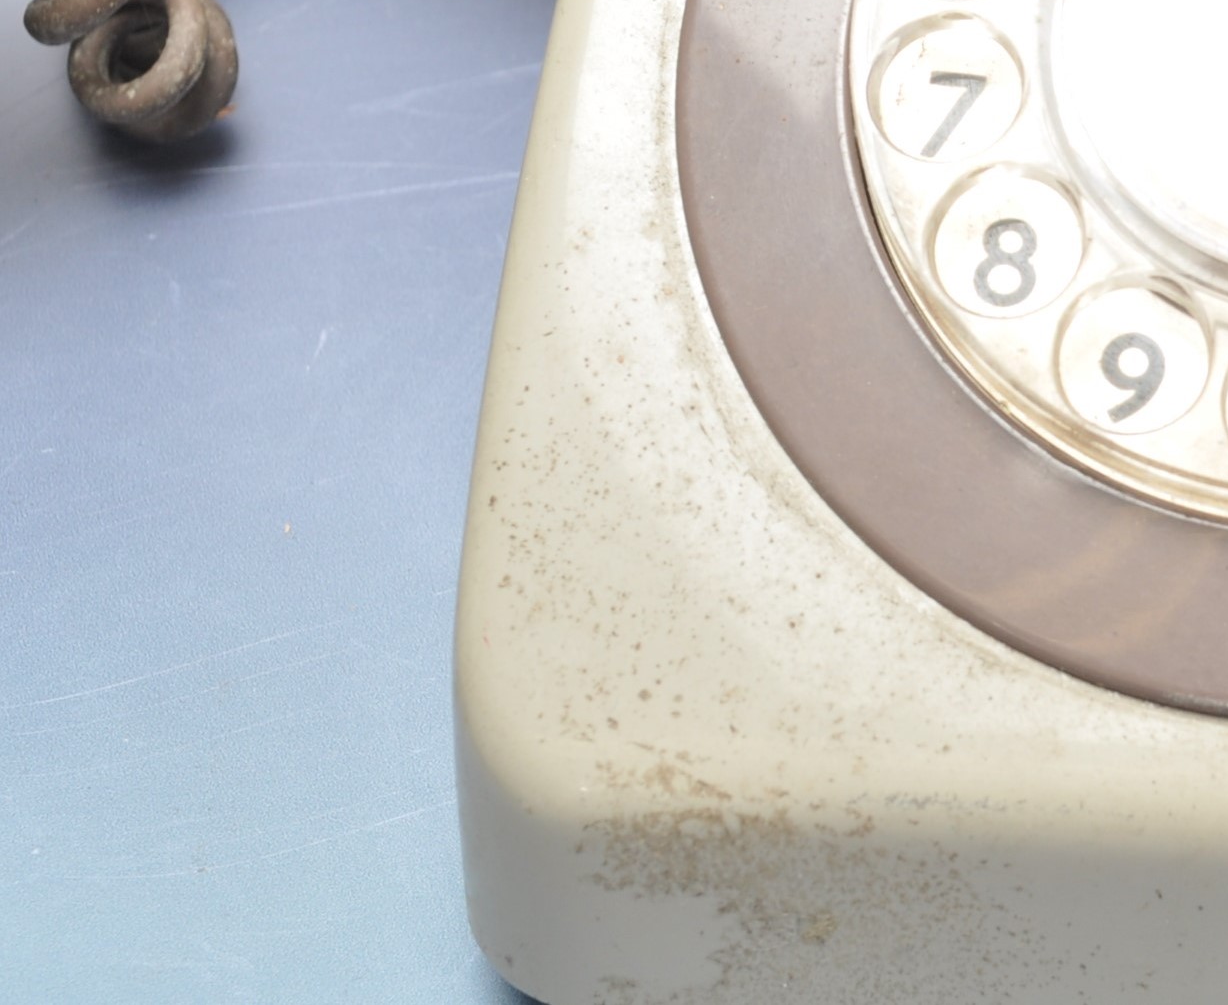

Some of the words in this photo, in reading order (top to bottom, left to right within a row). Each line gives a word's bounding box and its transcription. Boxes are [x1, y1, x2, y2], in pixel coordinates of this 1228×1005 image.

[921, 70, 987, 158] 7
[973, 218, 1038, 307] 8
[1099, 331, 1165, 423] 9
